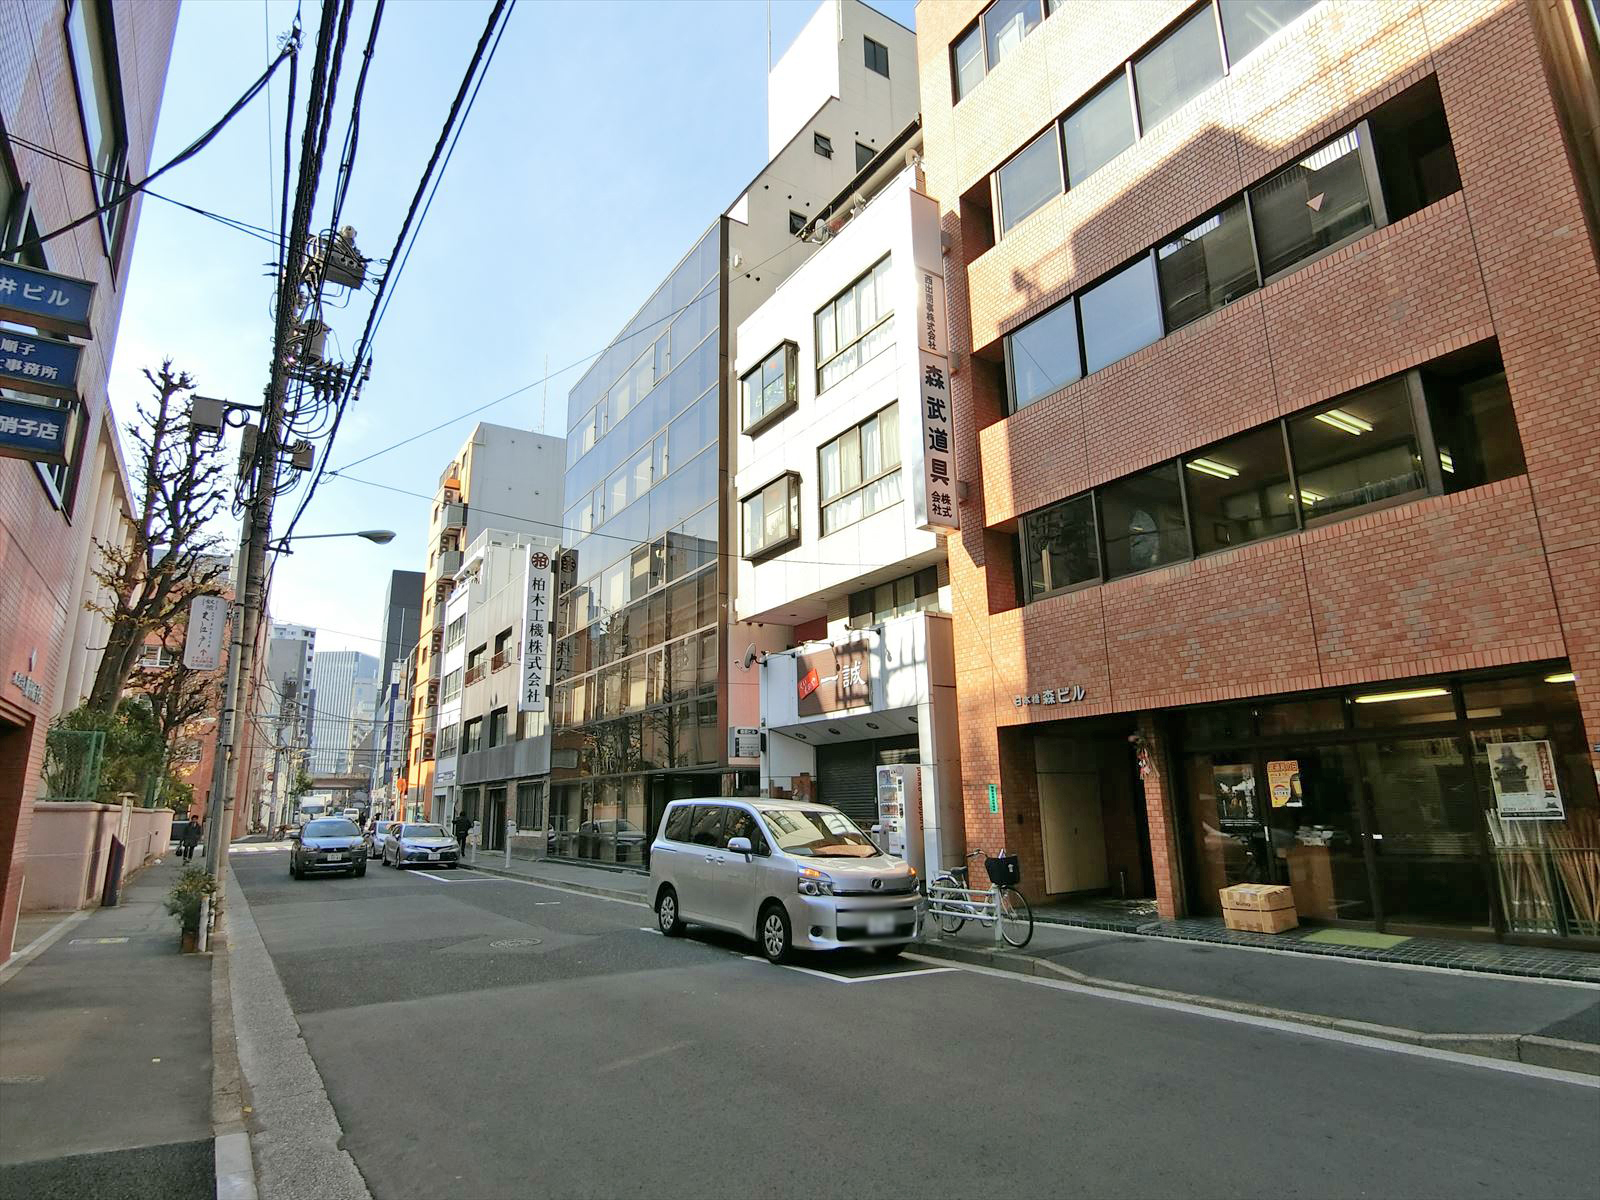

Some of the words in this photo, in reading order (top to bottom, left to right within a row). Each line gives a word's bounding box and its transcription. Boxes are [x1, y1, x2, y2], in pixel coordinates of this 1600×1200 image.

[0, 277, 70, 306] 井ビル
[0, 338, 36, 356] 順子
[0, 415, 60, 441] 硝子店
[925, 365, 950, 487] 森武道具
[931, 490, 942, 516] 会社
[941, 492, 952, 518] 株式
[527, 577, 546, 703] 柏木工機株式会社
[820, 660, 867, 689] 一誠
[1043, 684, 1086, 705] 森ビル
